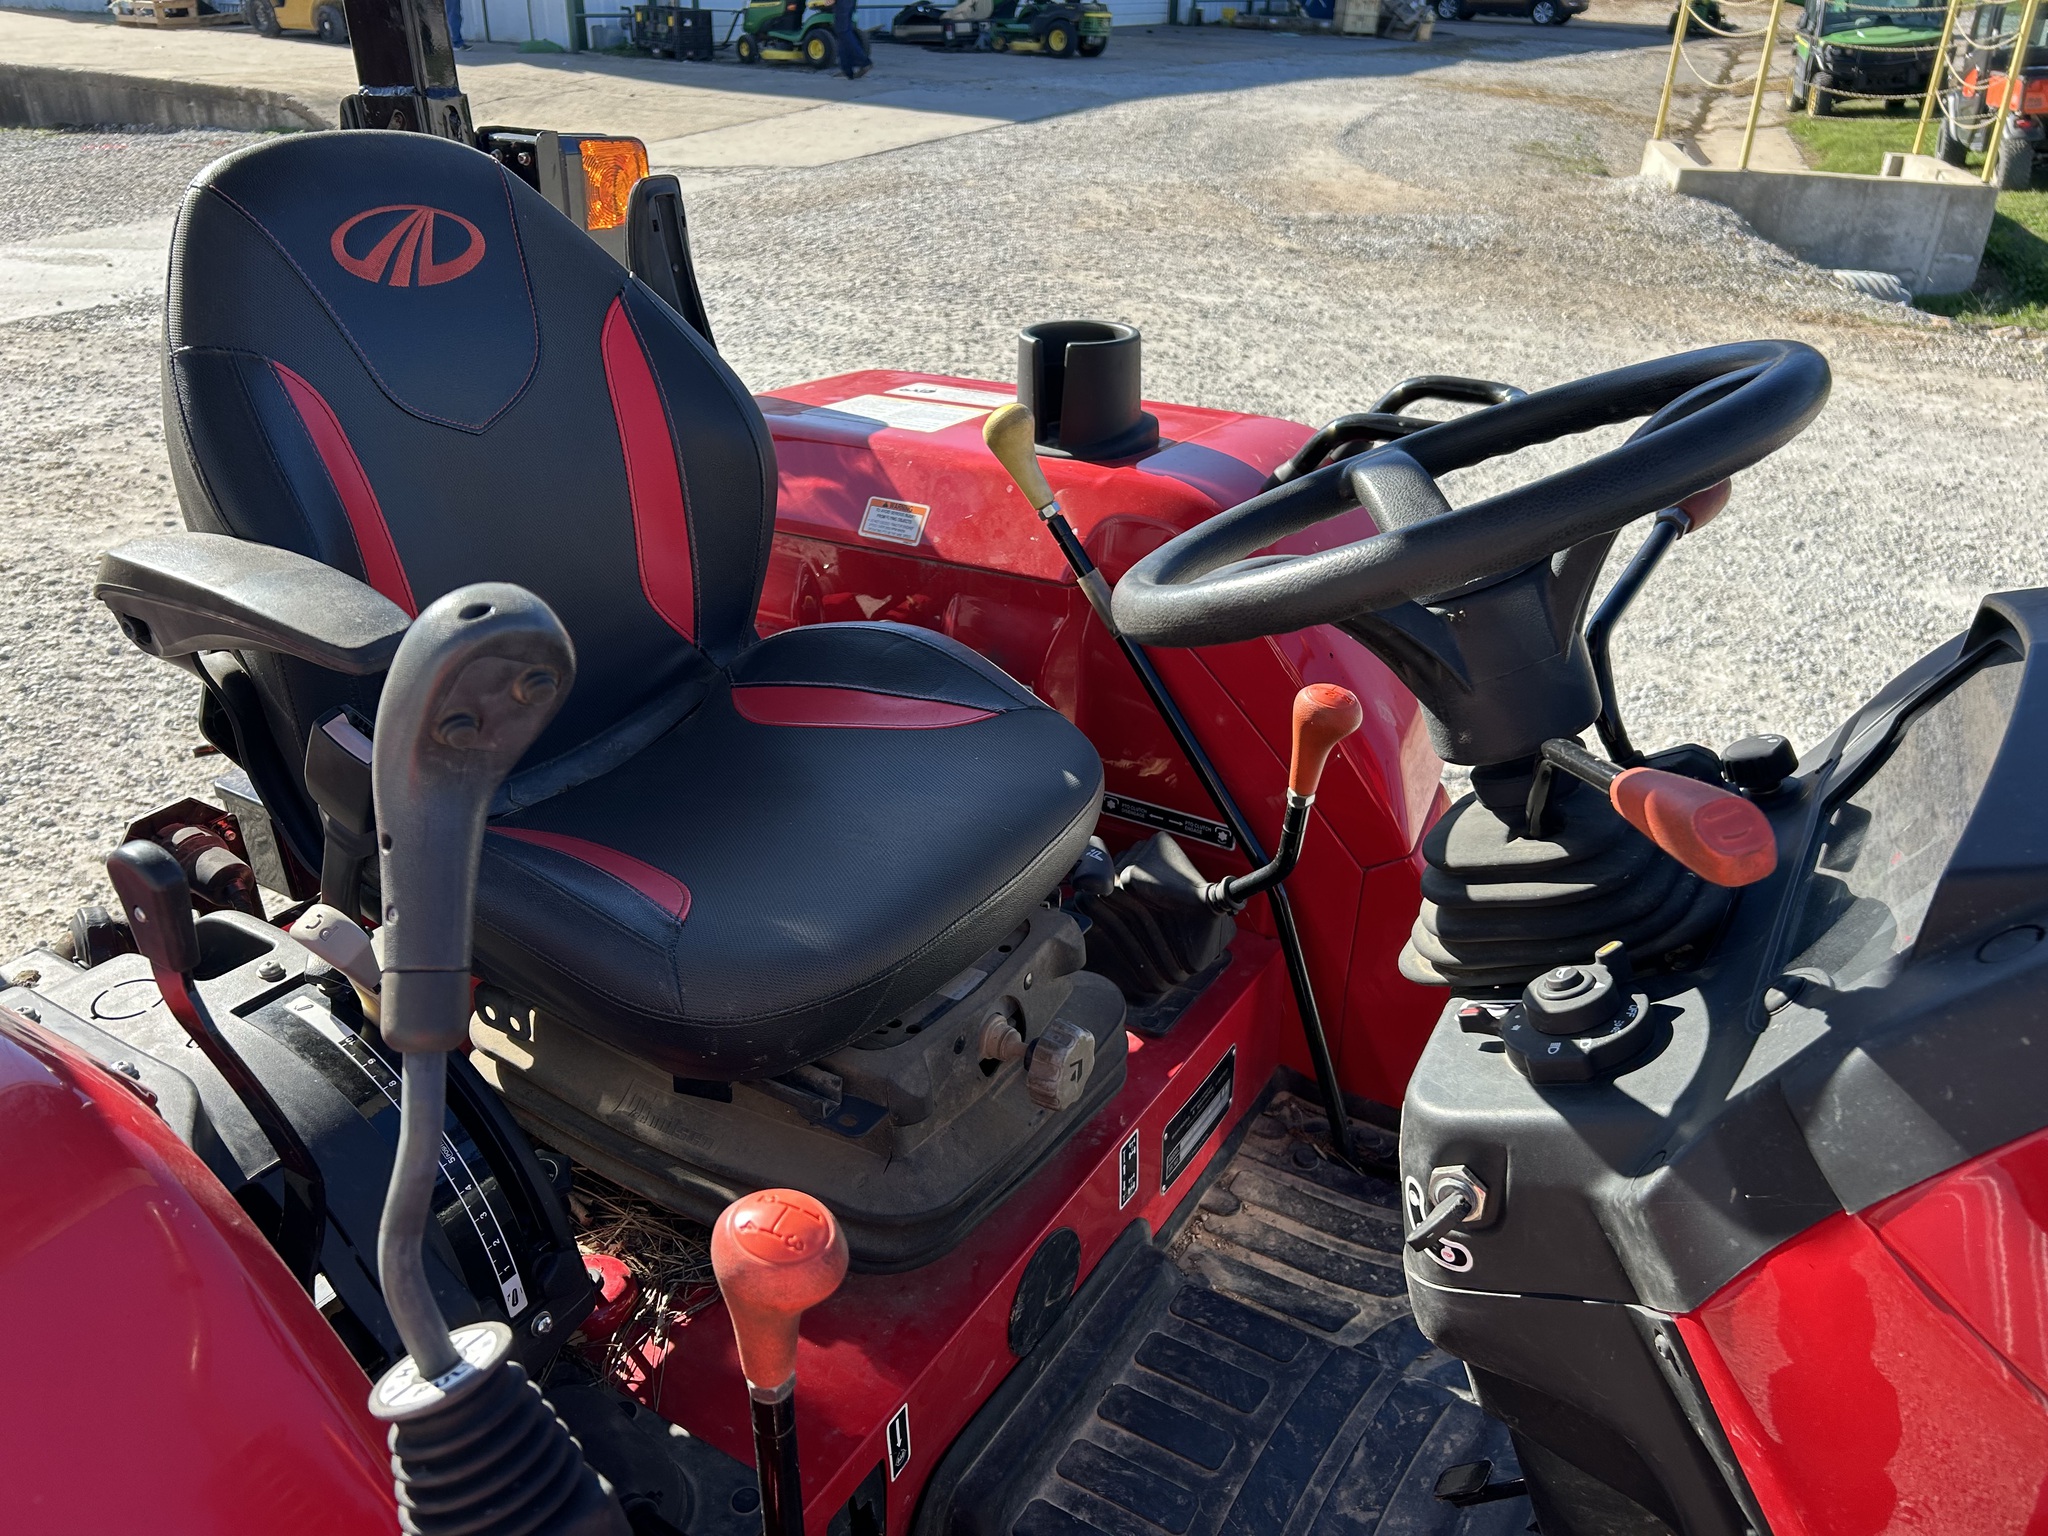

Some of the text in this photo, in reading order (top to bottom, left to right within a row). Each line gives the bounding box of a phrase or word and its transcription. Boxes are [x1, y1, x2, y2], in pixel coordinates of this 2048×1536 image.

[367, 1057, 376, 1065] 9
[447, 1155, 456, 1164] 5
[464, 1183, 472, 1191] 4
[479, 1211, 488, 1220] 3
[492, 1238, 501, 1246] 2
[785, 1234, 805, 1252] 3
[503, 1264, 510, 1272] 1
